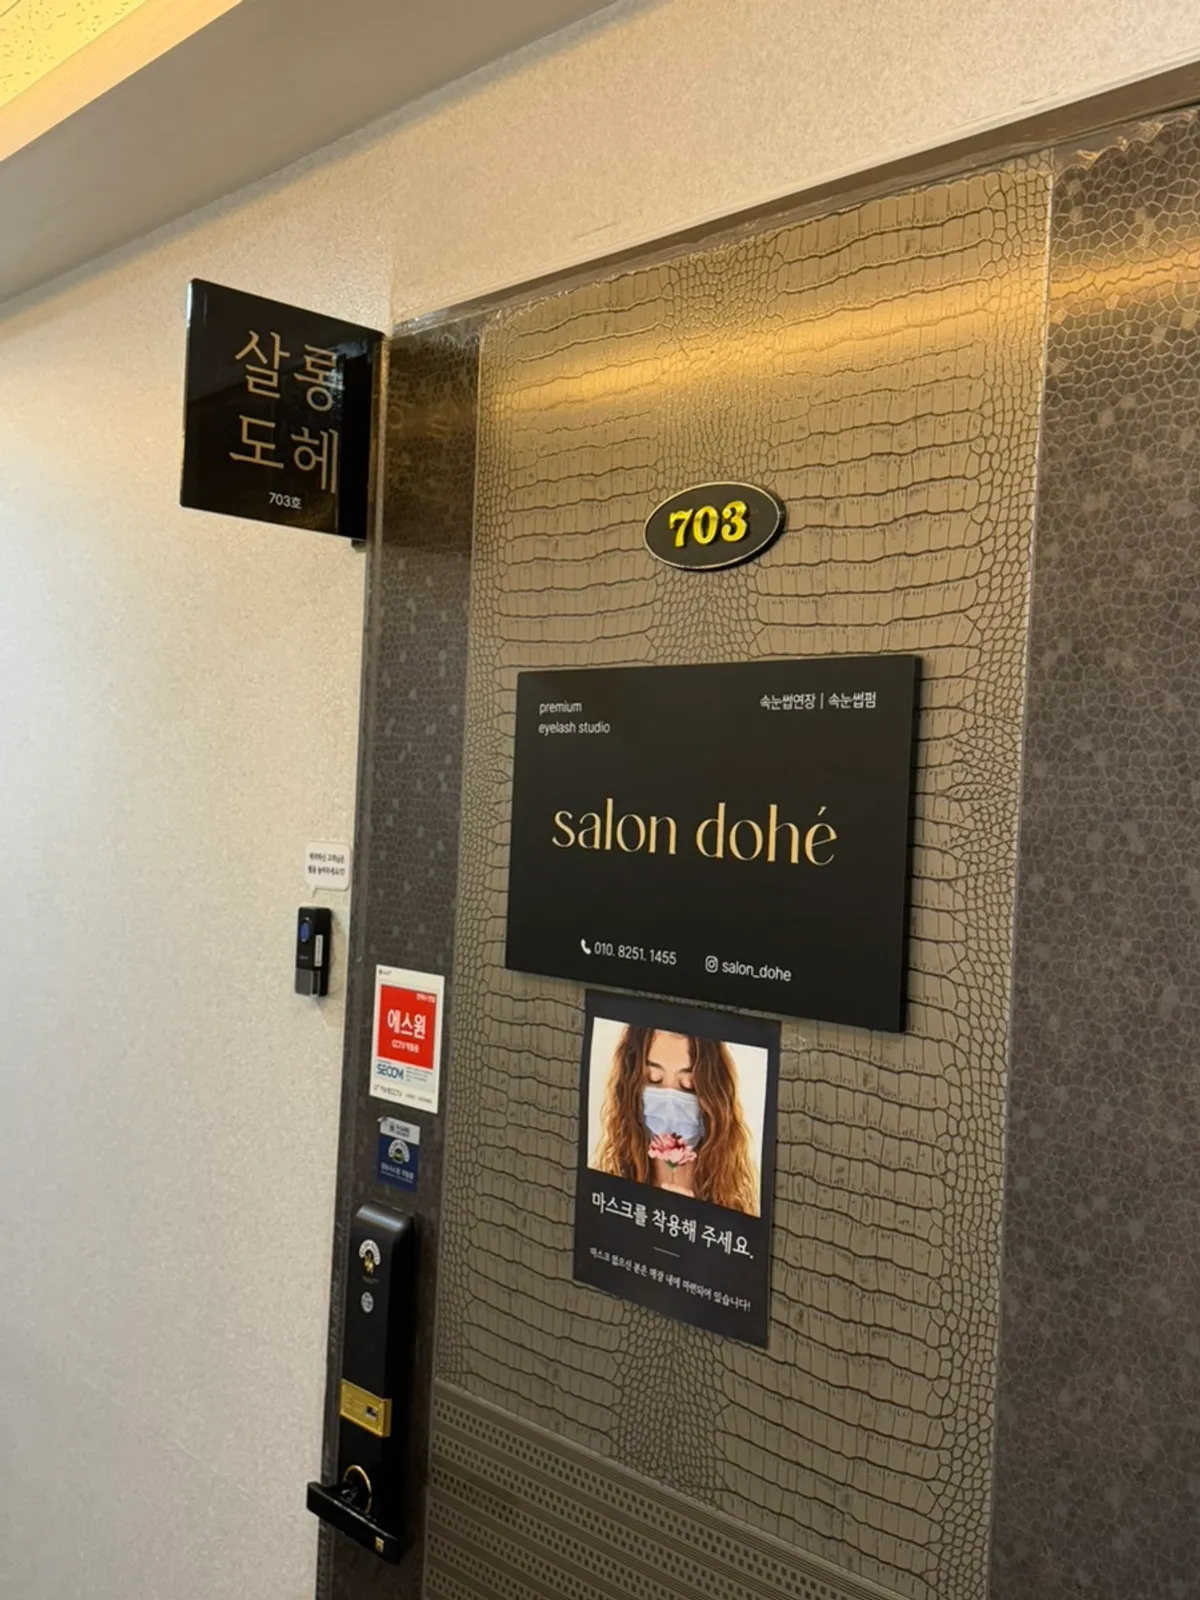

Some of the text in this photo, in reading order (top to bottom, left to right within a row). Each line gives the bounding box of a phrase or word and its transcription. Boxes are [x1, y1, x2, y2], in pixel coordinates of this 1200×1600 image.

[234, 330, 345, 412] 살롱
[228, 415, 339, 494] 도헤
[268, 491, 302, 510] 703호
[668, 500, 749, 549] 703
[539, 700, 583, 716] premium
[759, 690, 877, 711] 속눈썹연장 속눈썹펌
[538, 720, 611, 737] eyelash studio
[551, 797, 838, 867] salon dohé
[649, 949, 677, 967] 1455
[721, 960, 792, 983] salon_dohe
[387, 1008, 426, 1040] 에스원
[591, 1191, 754, 1260] 마스크를 착용해 주세요.
